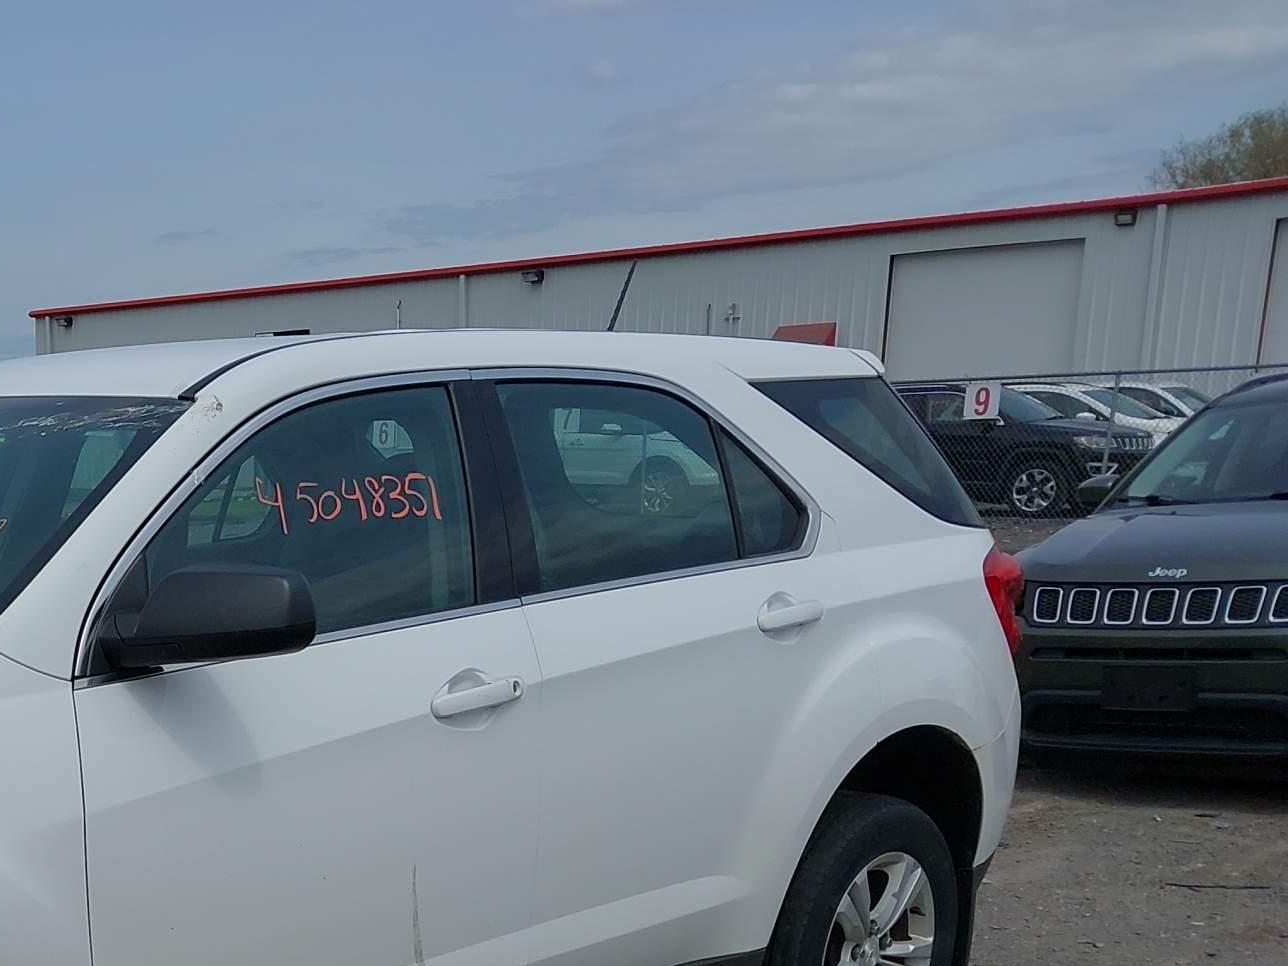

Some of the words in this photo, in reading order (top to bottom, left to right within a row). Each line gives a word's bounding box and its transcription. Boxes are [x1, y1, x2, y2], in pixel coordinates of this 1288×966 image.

[974, 386, 991, 416] 9
[378, 422, 389, 445] 6
[255, 472, 442, 535] 45048351
[1148, 566, 1188, 578] Jeep
